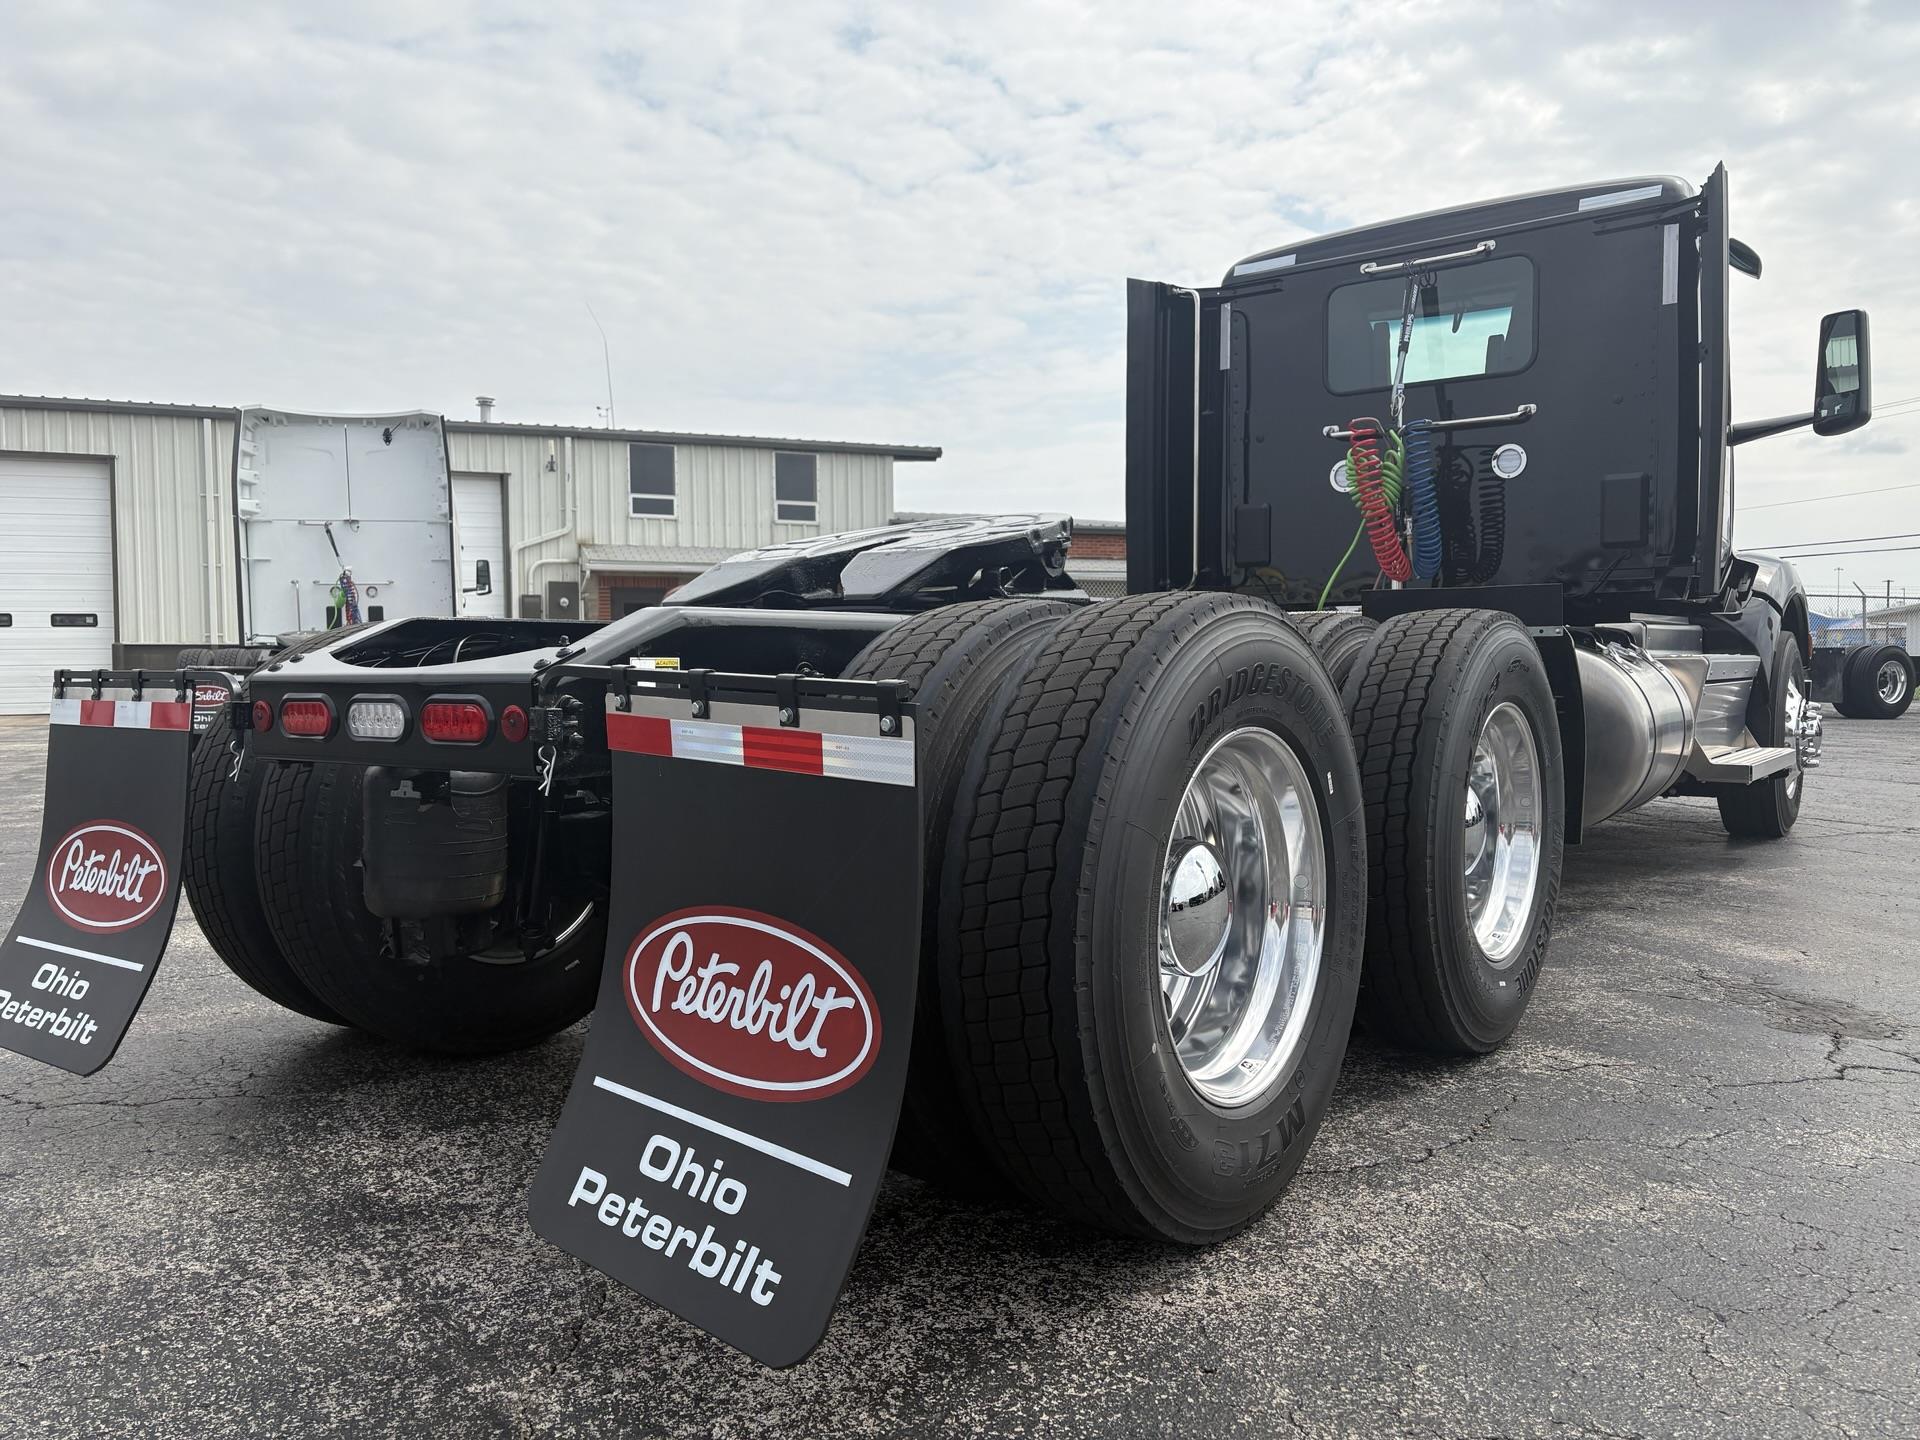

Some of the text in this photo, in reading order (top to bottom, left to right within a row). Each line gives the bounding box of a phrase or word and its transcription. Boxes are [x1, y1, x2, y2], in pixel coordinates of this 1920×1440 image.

[1188, 661, 1337, 753] BRIDGESTONE
[59, 838, 158, 903] Peterbilt
[31, 962, 90, 1001] Ohio
[651, 931, 856, 1058] Peterbilt
[639, 1134, 748, 1216] Ohio
[567, 1166, 783, 1306] Peterbilt
